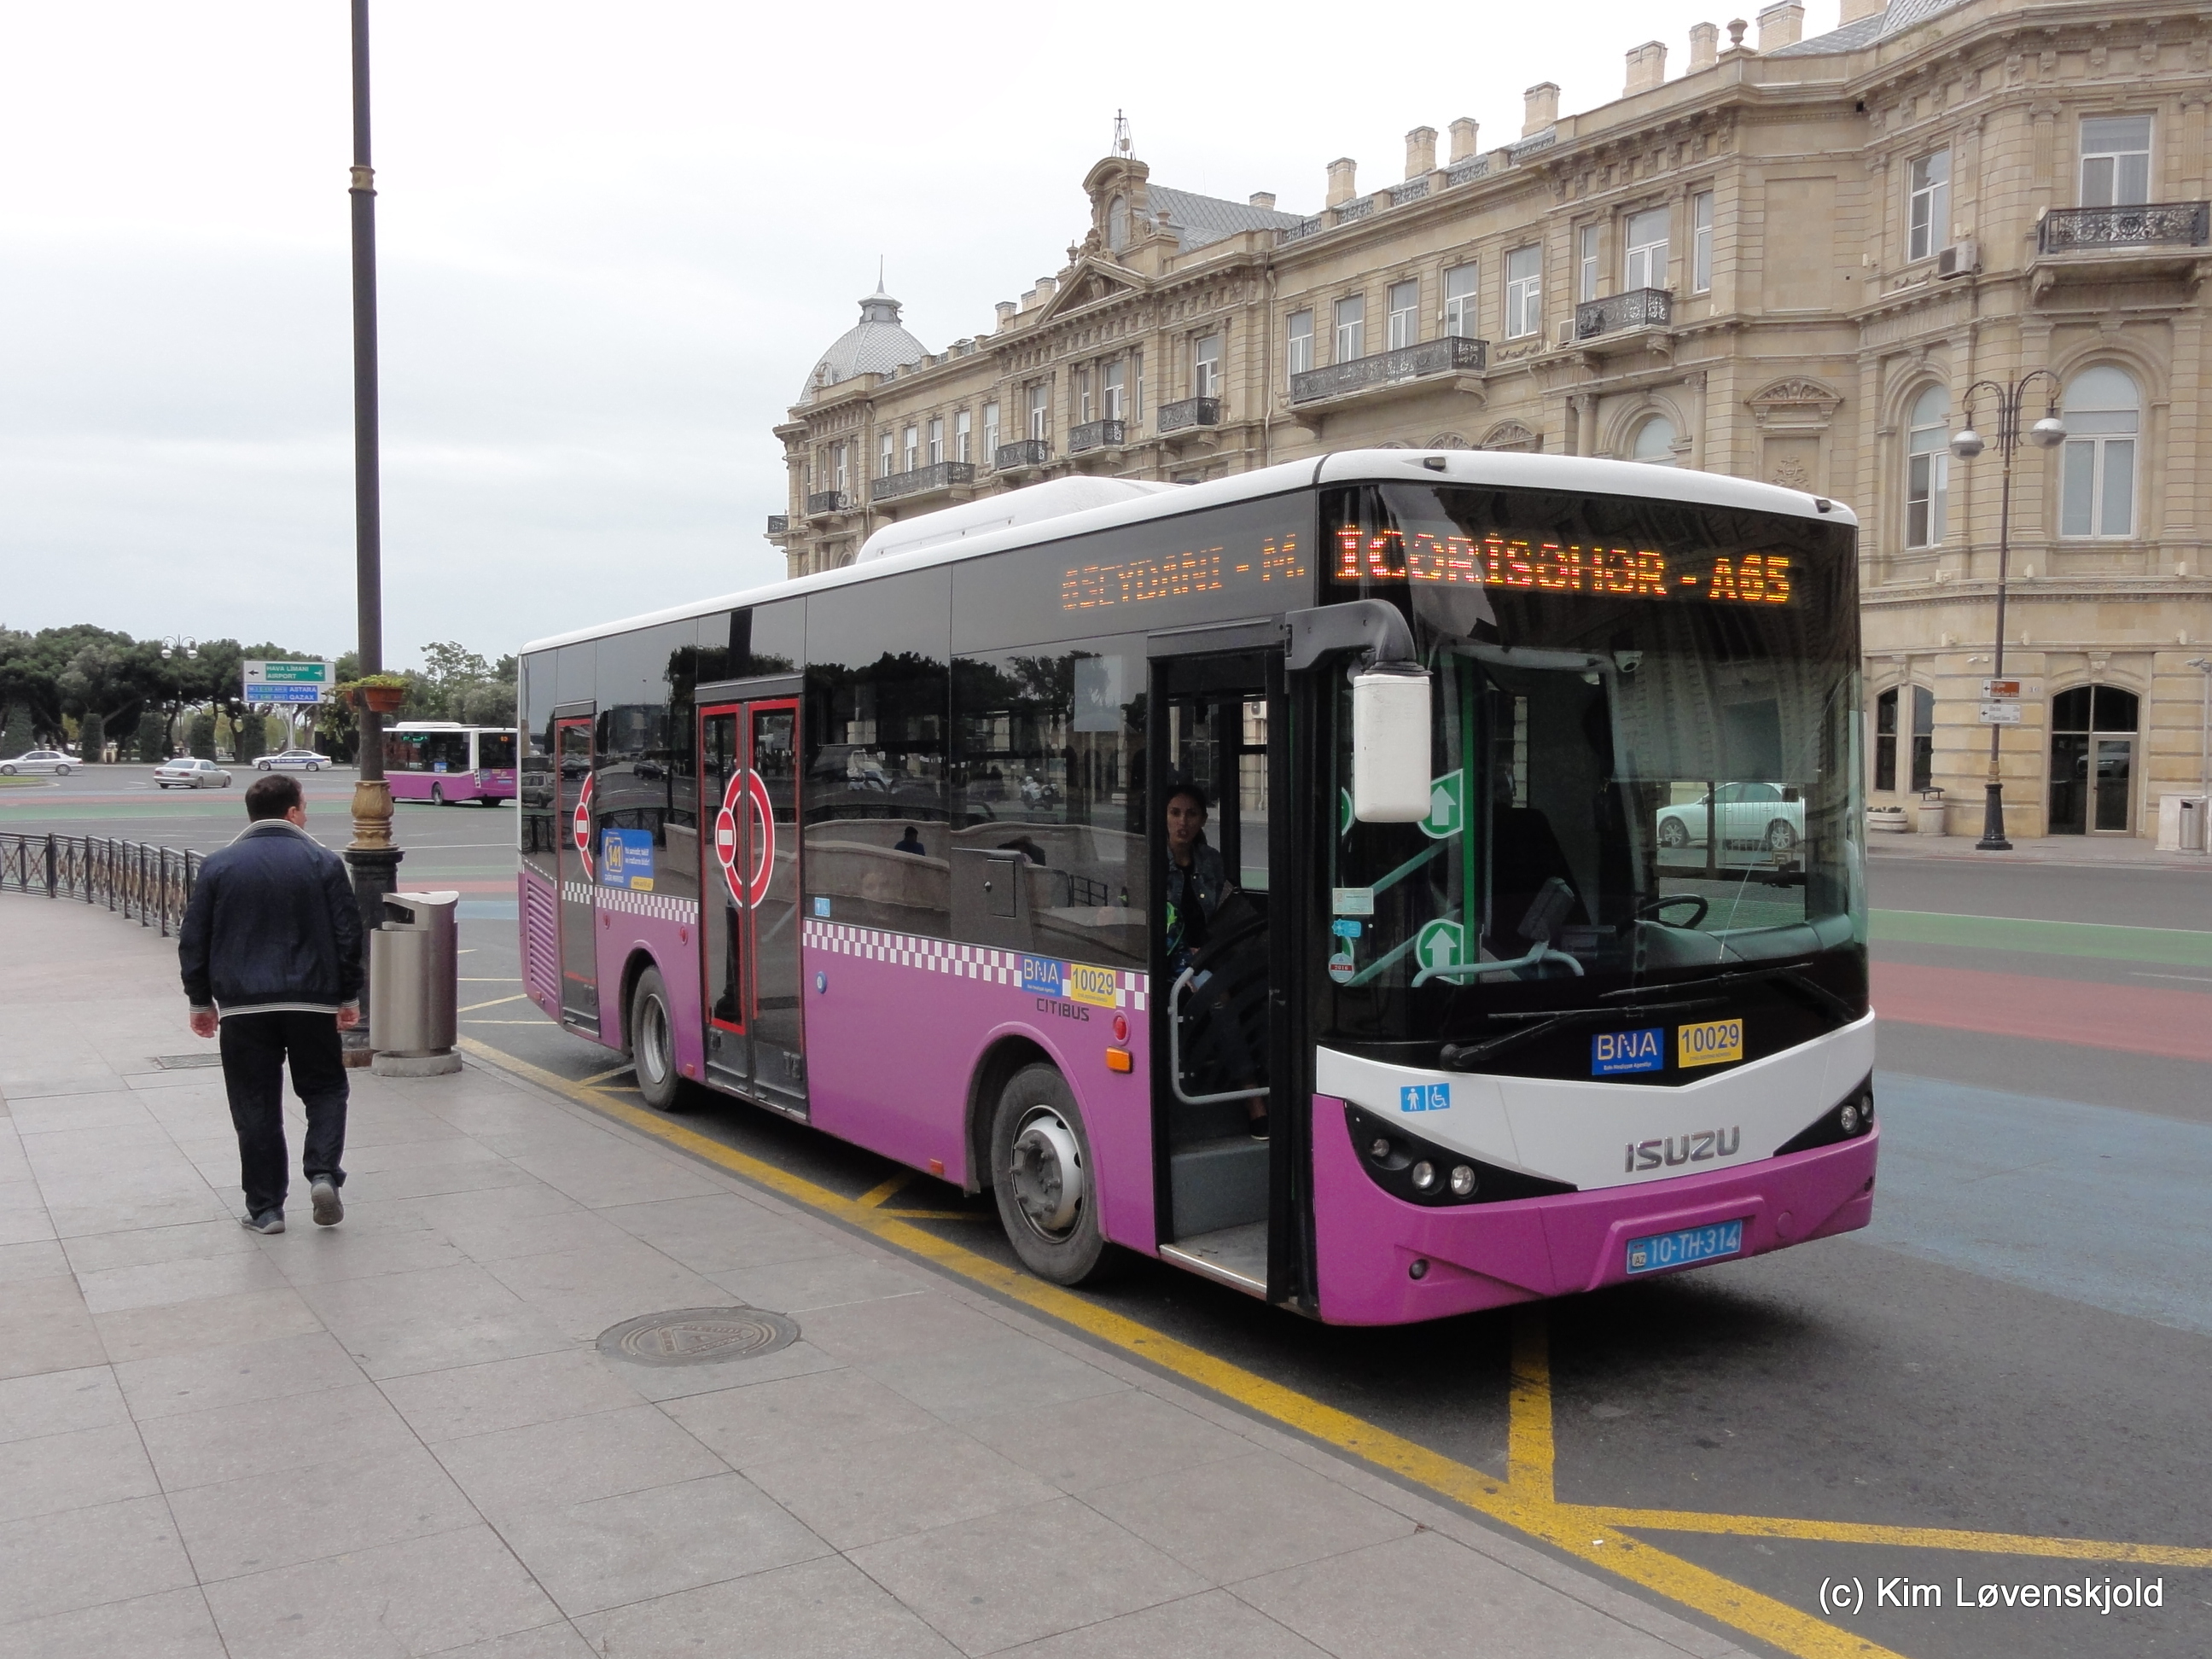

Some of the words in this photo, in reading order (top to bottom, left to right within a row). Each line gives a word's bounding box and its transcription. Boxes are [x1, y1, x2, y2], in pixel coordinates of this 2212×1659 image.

[608, 845, 620, 867] 141
[1024, 958, 1059, 985] BNA
[1073, 967, 1115, 996] 10029
[1036, 997, 1090, 1022] CITIBUS
[1598, 1032, 1657, 1061] BNA
[1682, 1023, 1740, 1054] 10029
[1625, 1125, 1740, 1173] ISUZU
[1633, 1254, 1645, 1266] AZ
